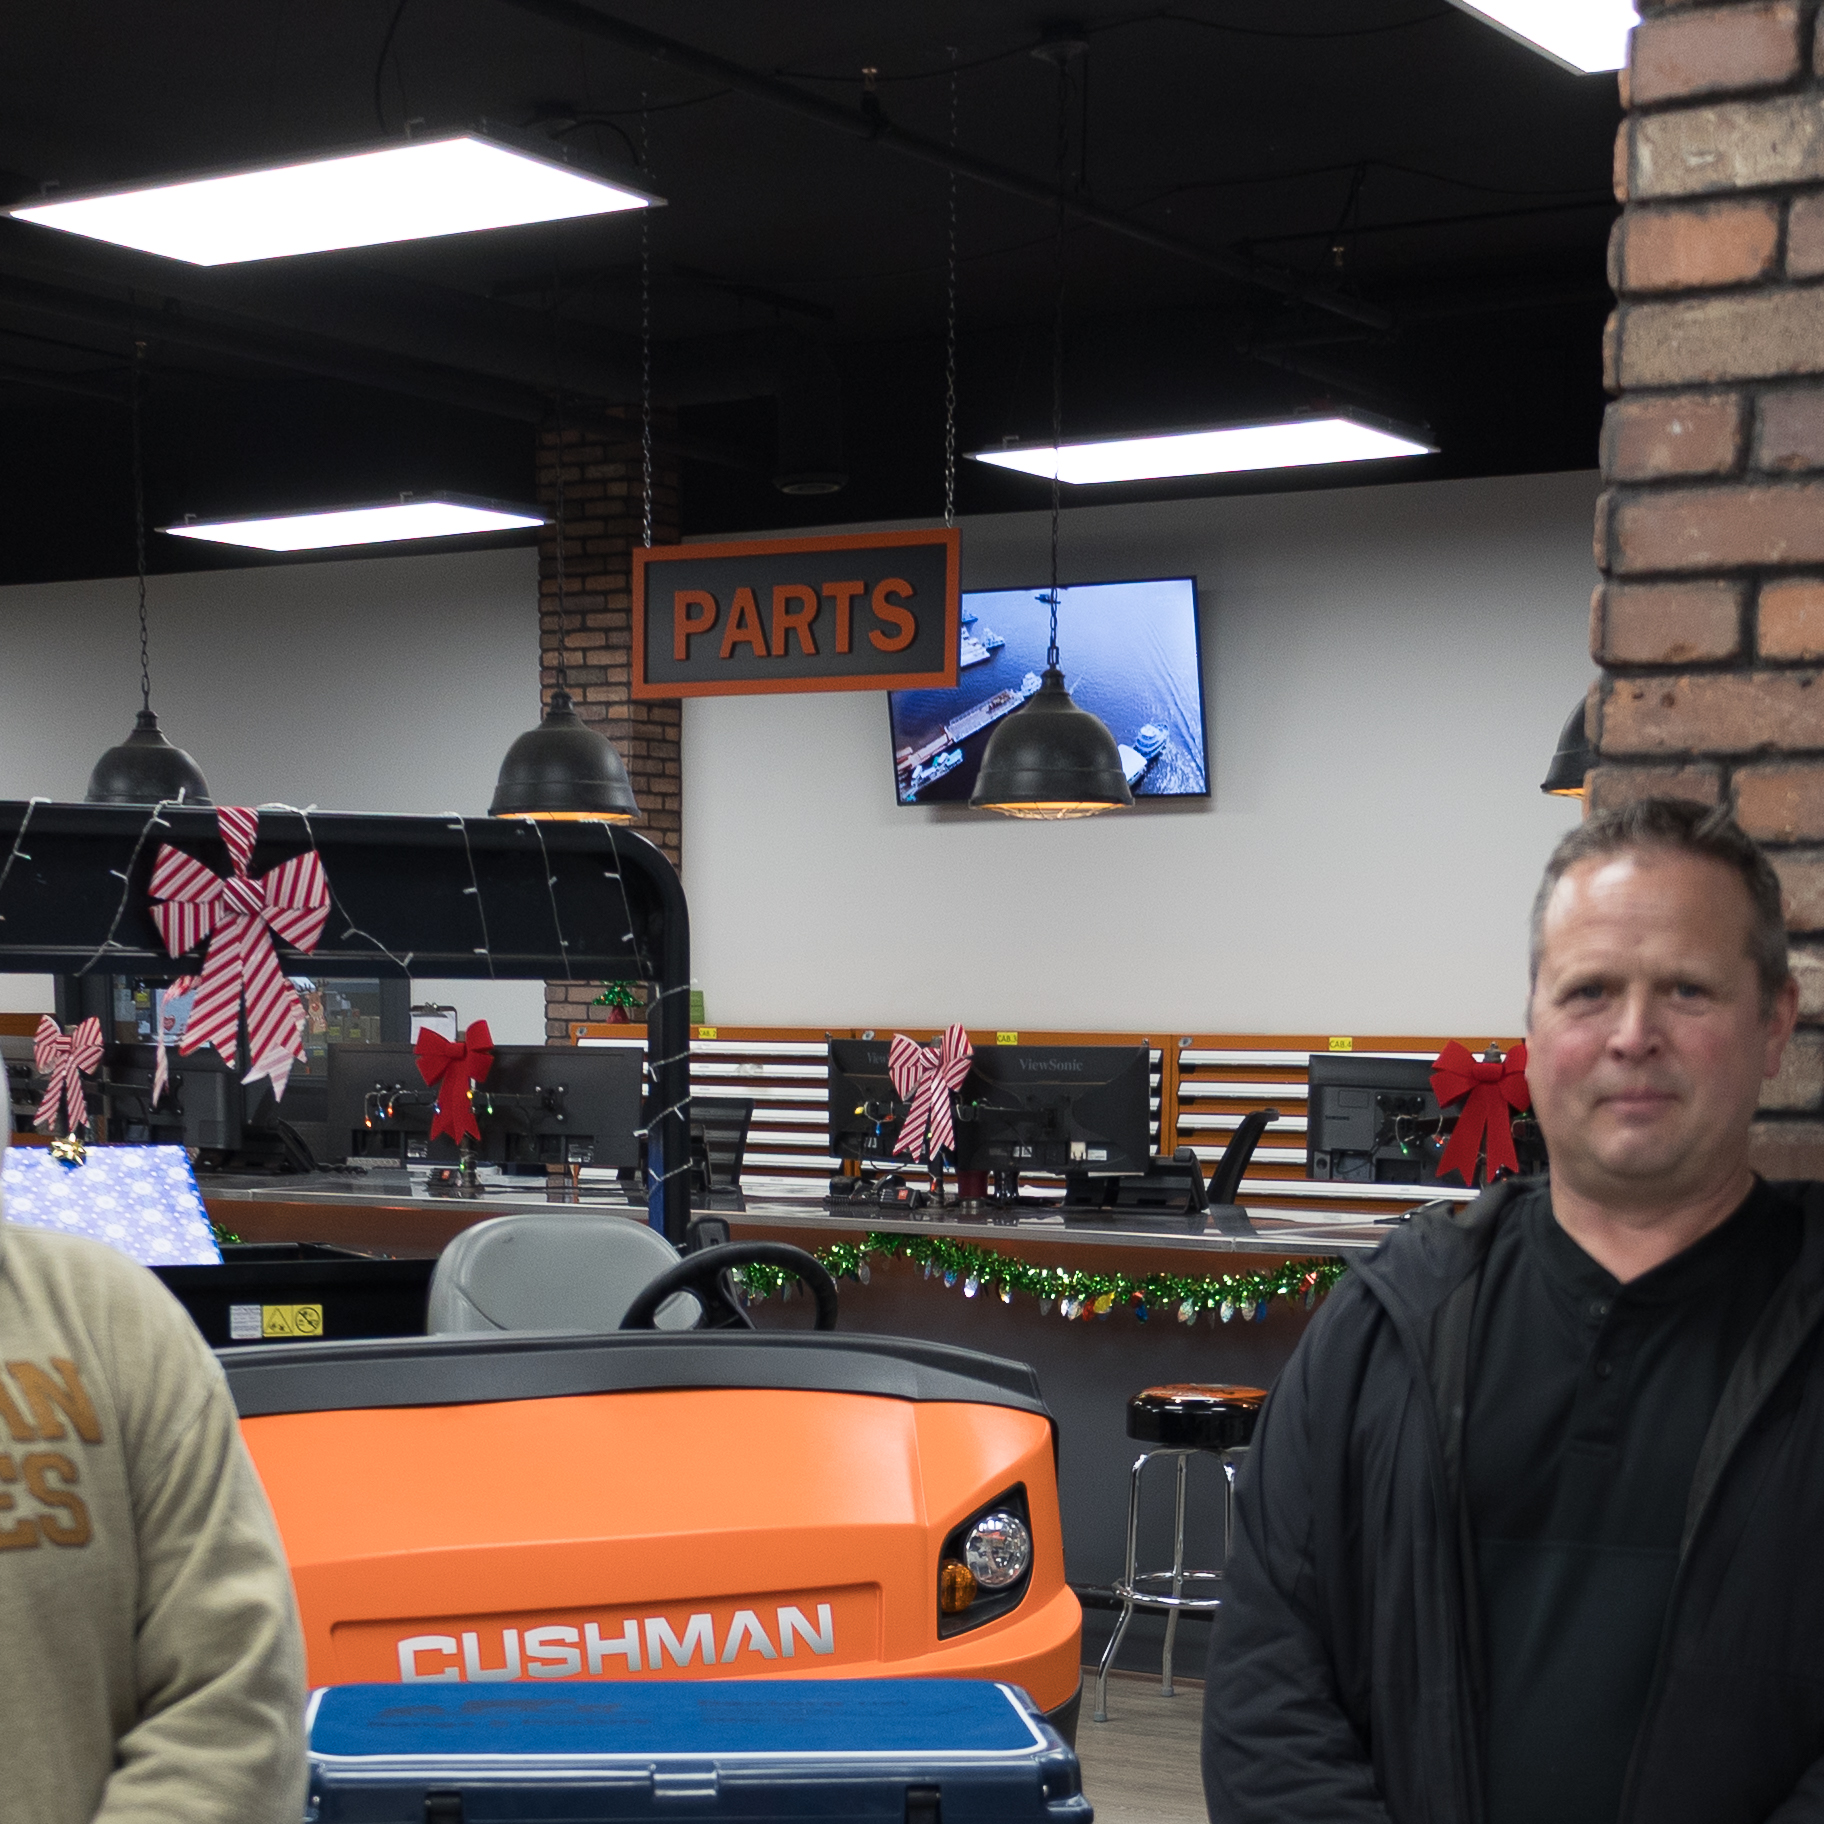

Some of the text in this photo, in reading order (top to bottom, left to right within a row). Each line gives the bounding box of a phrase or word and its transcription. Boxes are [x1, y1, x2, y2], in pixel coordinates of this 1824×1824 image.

[673, 577, 918, 660] PARTS
[1019, 1058, 1084, 1072] ViewSonic
[397, 1604, 835, 1683] CUSHMAN
